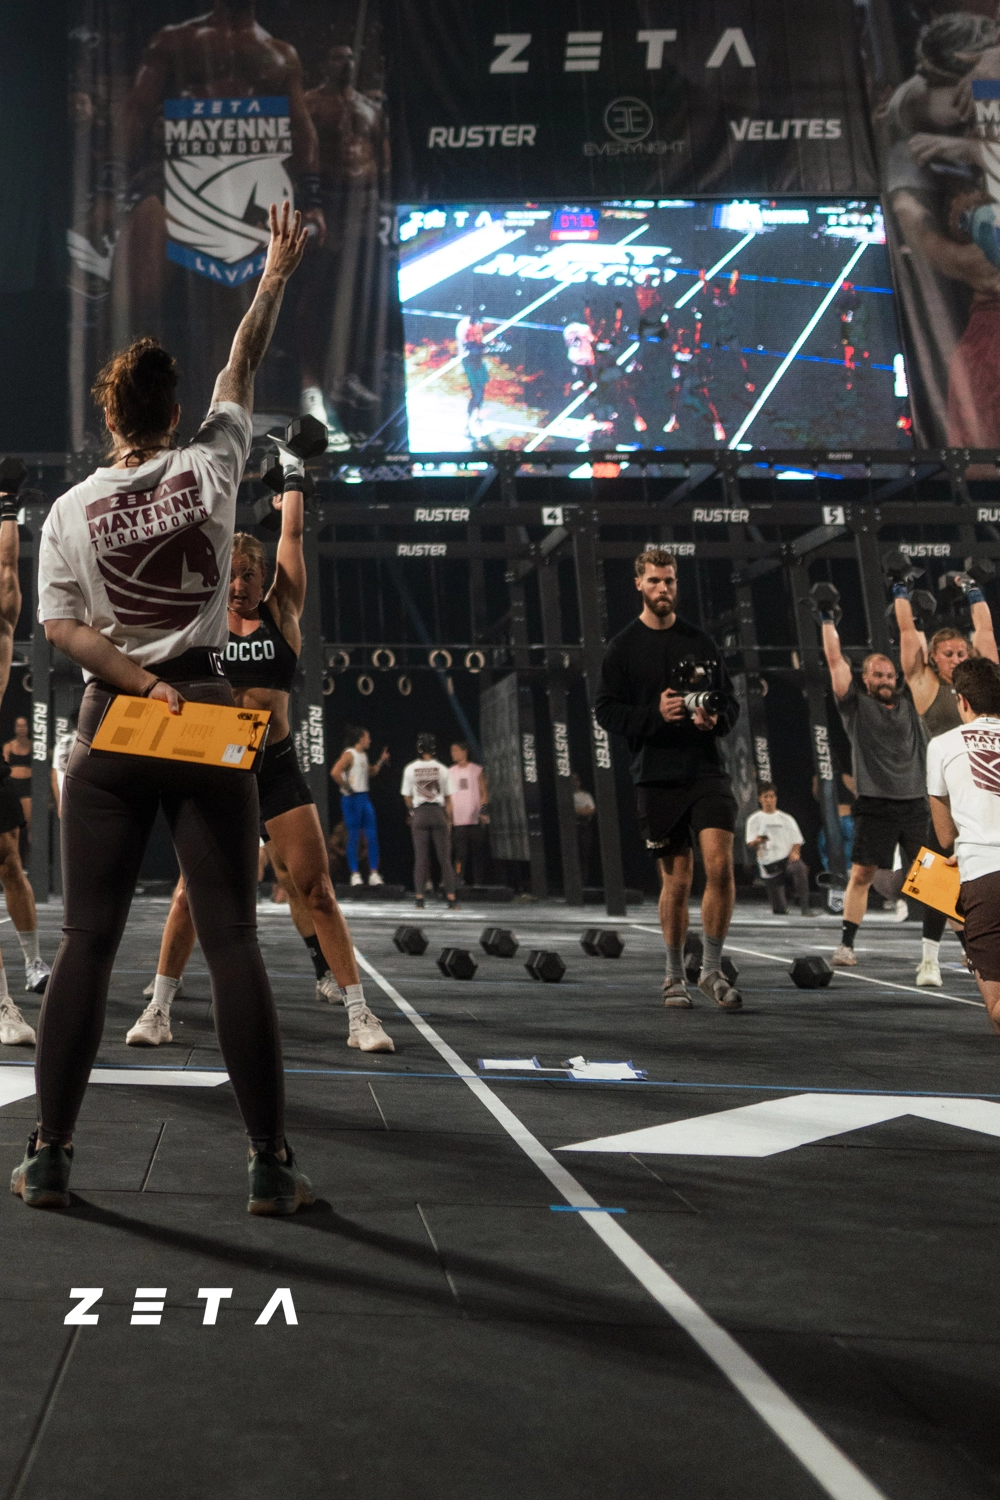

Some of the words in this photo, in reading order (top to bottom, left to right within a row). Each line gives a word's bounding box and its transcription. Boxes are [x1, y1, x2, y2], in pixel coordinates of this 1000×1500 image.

[489, 27, 756, 74] ZETA
[192, 100, 261, 114] ZETA
[164, 116, 291, 141] MAYENNE
[428, 124, 537, 149] RUSTER
[729, 117, 842, 141] VELITES
[165, 138, 293, 155] THROWDOWN
[110, 484, 171, 508] ZETA
[88, 489, 204, 539] MAYENNE
[415, 508, 470, 522] RUSTER
[692, 507, 750, 523] RUSTER
[978, 508, 1000, 522] RU
[92, 507, 209, 551] THROWDOWN
[397, 543, 447, 556] RUSTER
[220, 640, 276, 661] OCCO
[33, 701, 48, 761] RUSTER
[308, 704, 325, 765] RUSTER
[591, 707, 611, 769] STER
[522, 733, 538, 783] RUSTER
[553, 721, 571, 777] RUSTER
[814, 724, 833, 780] RUSTER
